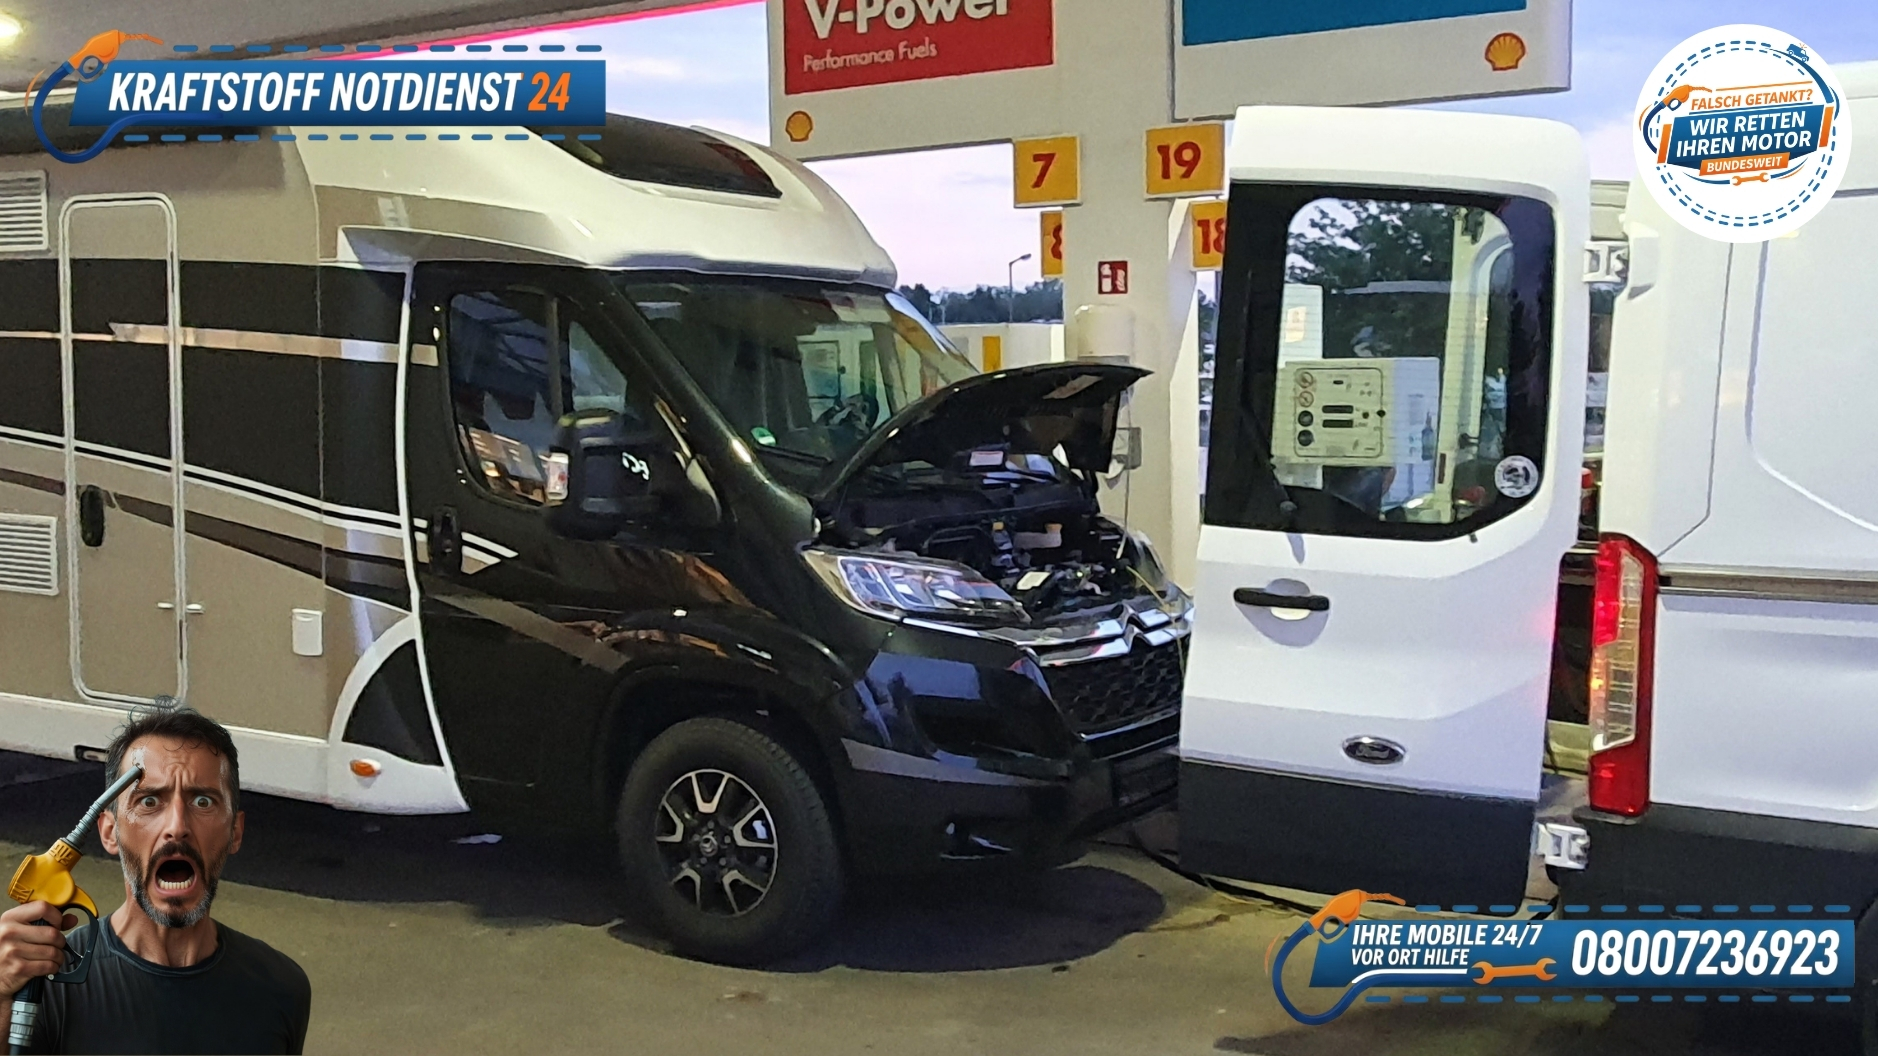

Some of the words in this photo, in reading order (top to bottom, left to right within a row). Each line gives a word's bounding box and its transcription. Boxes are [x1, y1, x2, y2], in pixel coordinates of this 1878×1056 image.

[803, 49, 894, 72] Performance
[899, 37, 938, 60] Fuels
[1031, 152, 1057, 189] 7
[1156, 141, 1202, 180] 19
